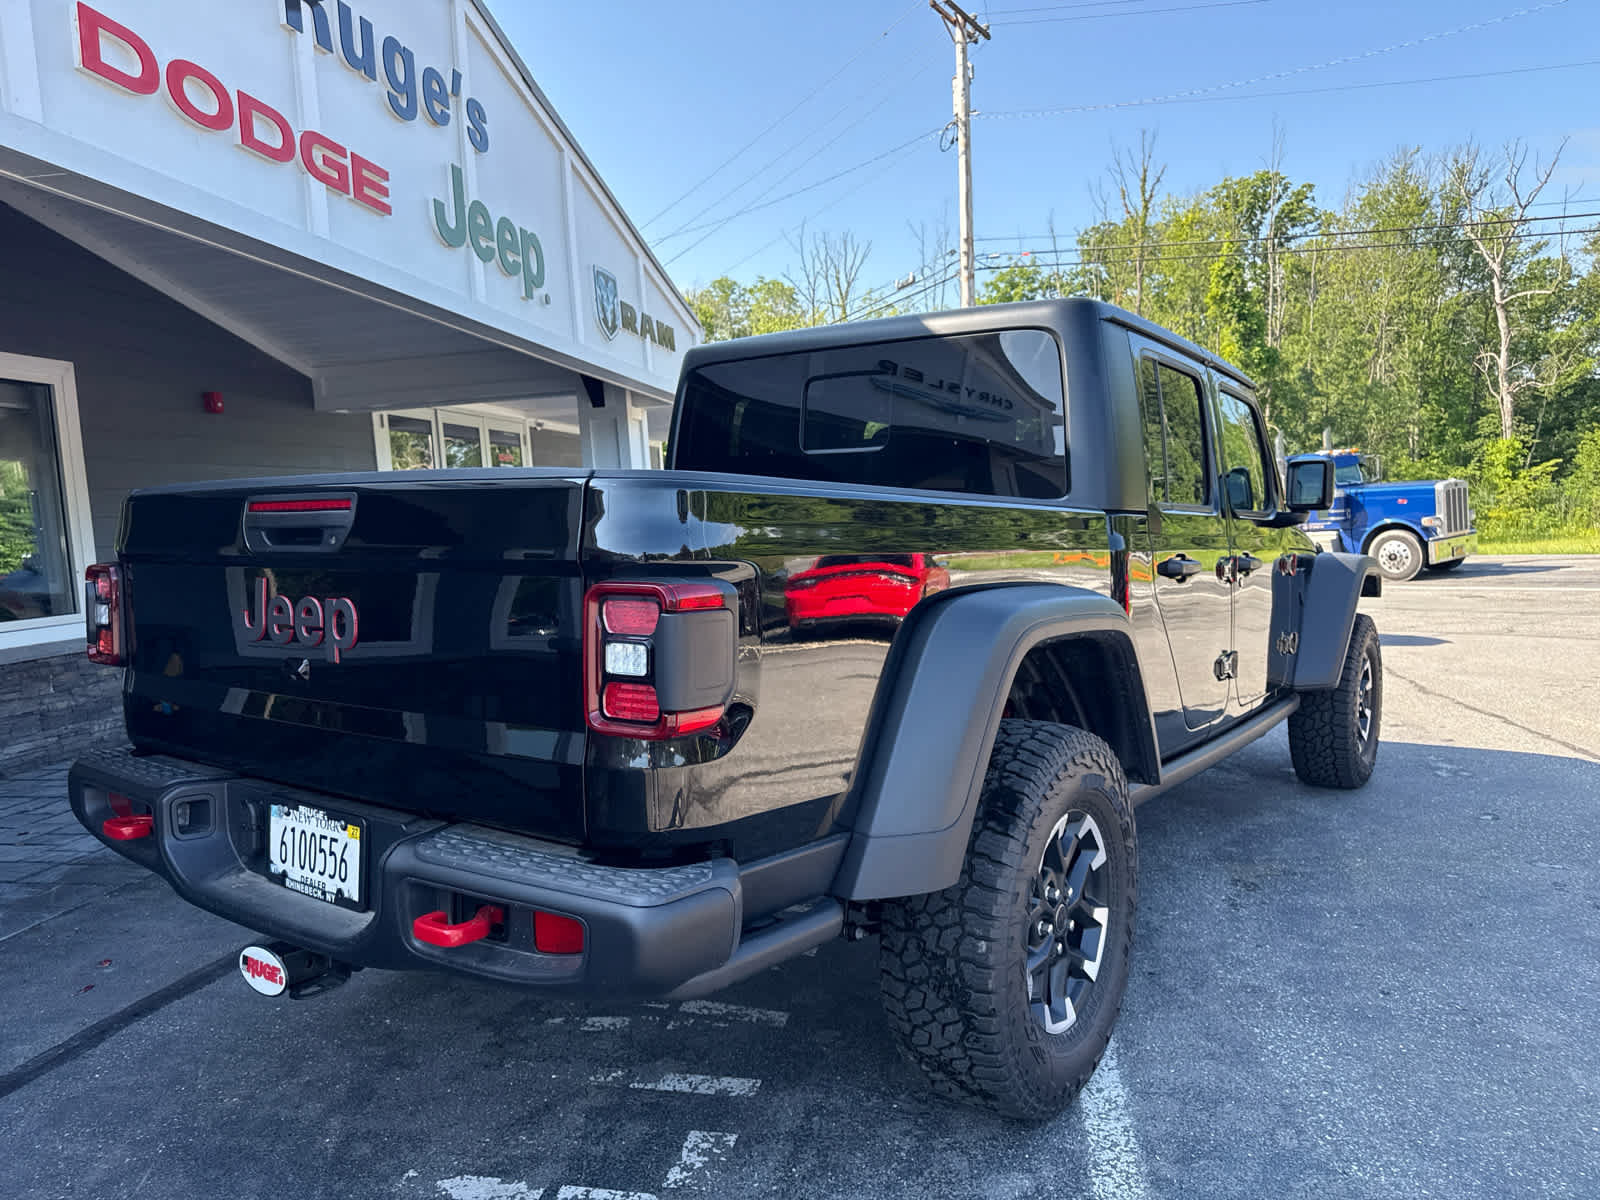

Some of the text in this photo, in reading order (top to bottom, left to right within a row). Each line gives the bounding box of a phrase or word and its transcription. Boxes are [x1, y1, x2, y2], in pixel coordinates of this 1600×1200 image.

[75, 1, 393, 216] DODGE
[619, 300, 676, 353] RAM
[241, 576, 359, 664] Jeep
[280, 826, 348, 883] 6100556
[301, 875, 326, 890] DEALER
[326, 892, 336, 904] NY
